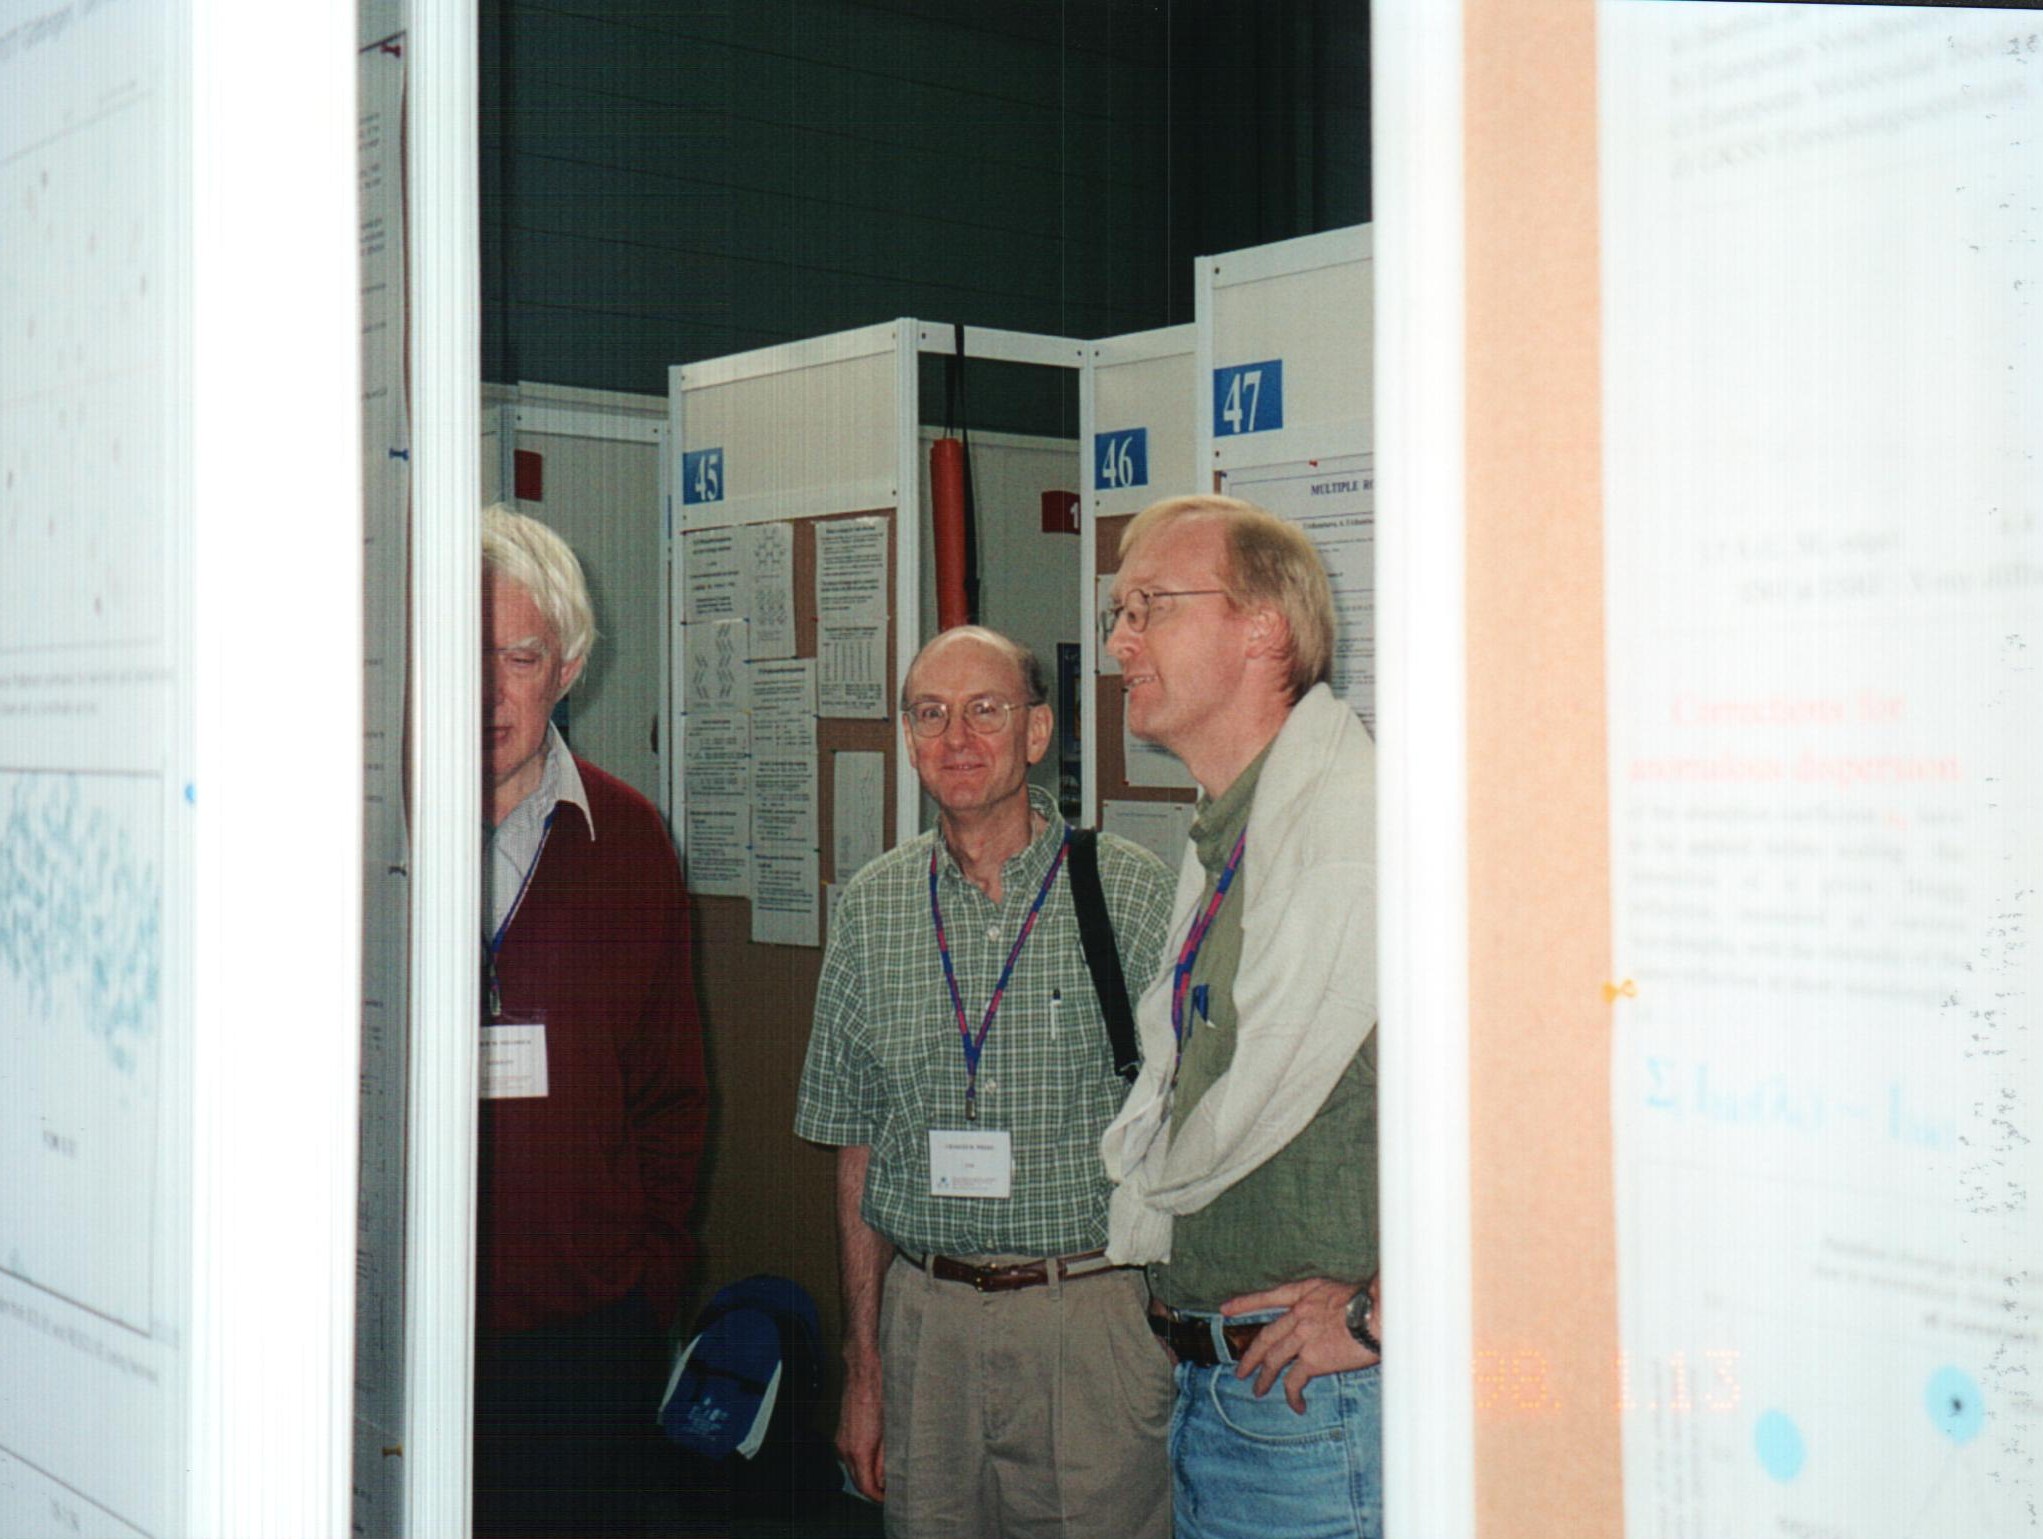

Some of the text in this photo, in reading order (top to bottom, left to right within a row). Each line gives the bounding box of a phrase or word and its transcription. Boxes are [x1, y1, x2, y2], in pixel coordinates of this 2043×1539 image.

[1223, 370, 1263, 433] 47
[694, 454, 718, 501] 45
[1102, 436, 1133, 488] 46
[1311, 481, 1358, 495] MULTIPLE
